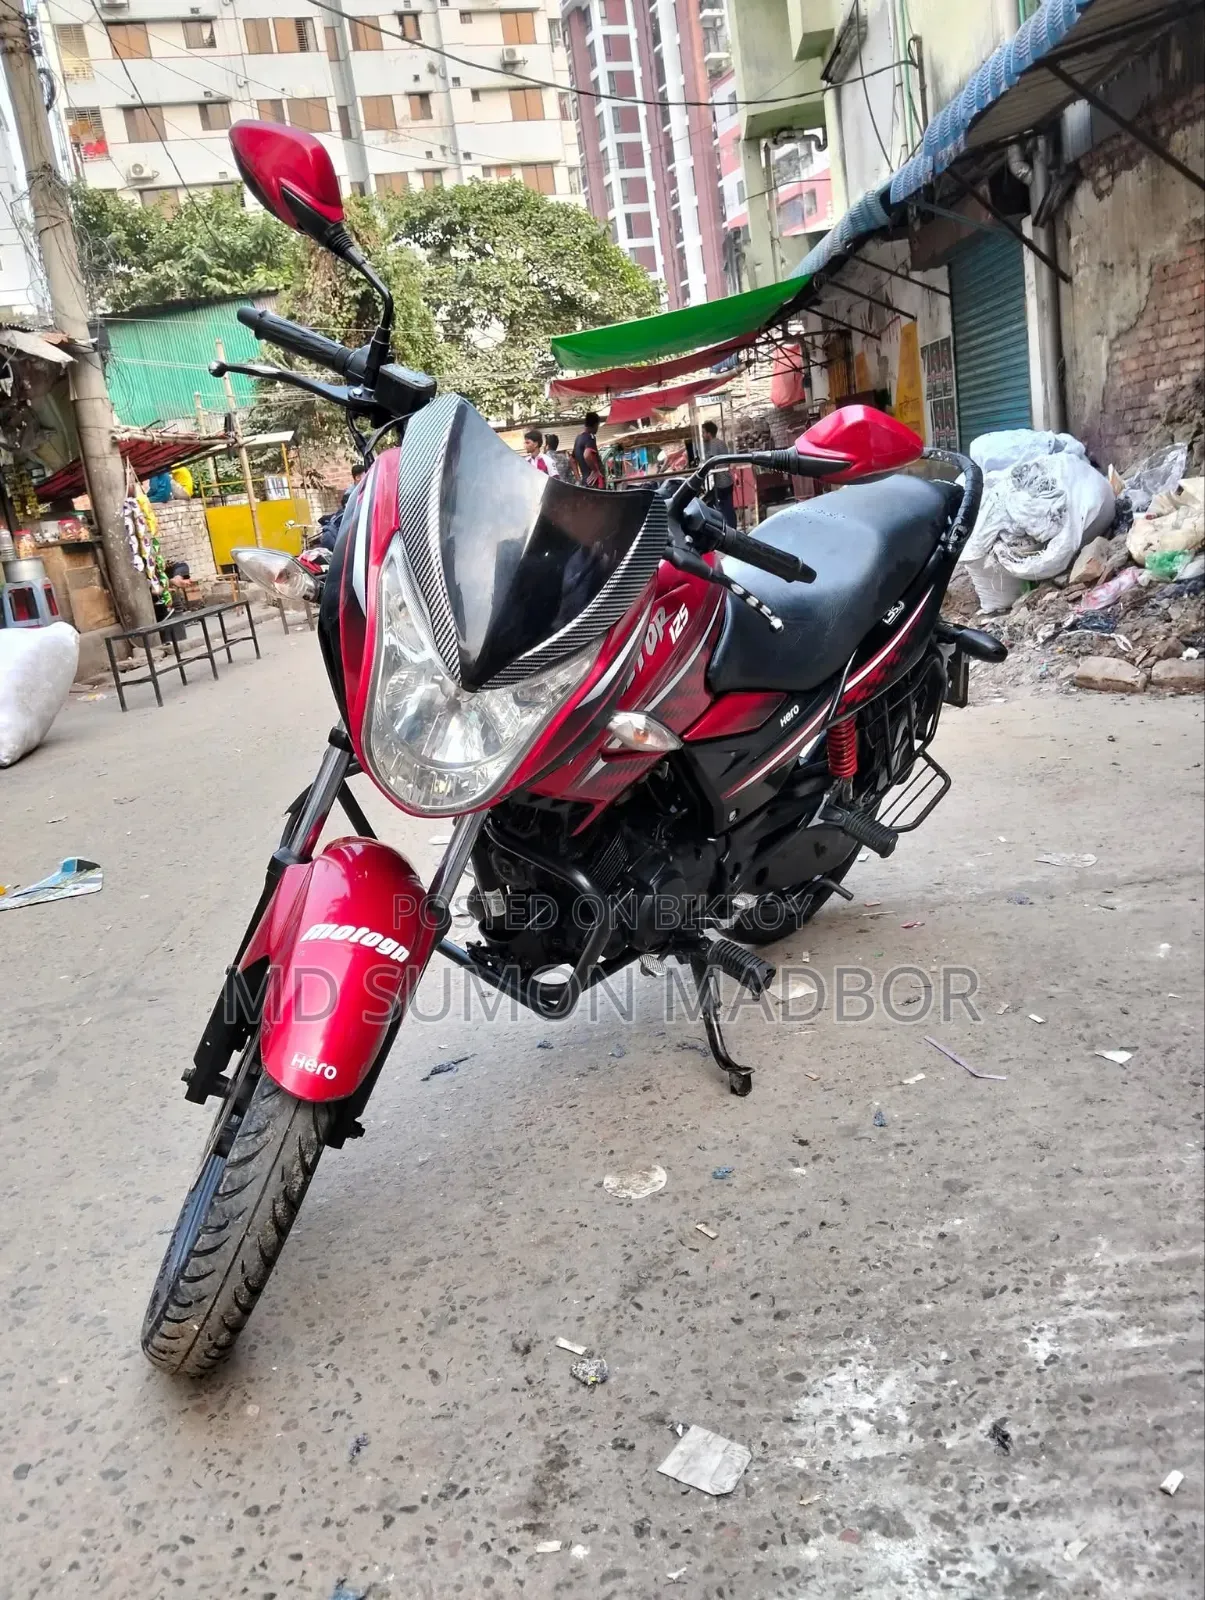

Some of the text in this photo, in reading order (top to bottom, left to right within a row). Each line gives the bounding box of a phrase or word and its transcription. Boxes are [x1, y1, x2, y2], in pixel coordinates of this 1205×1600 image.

[669, 603, 689, 645] 125
[780, 704, 799, 727] Hero
[291, 1053, 337, 1080] Hero
